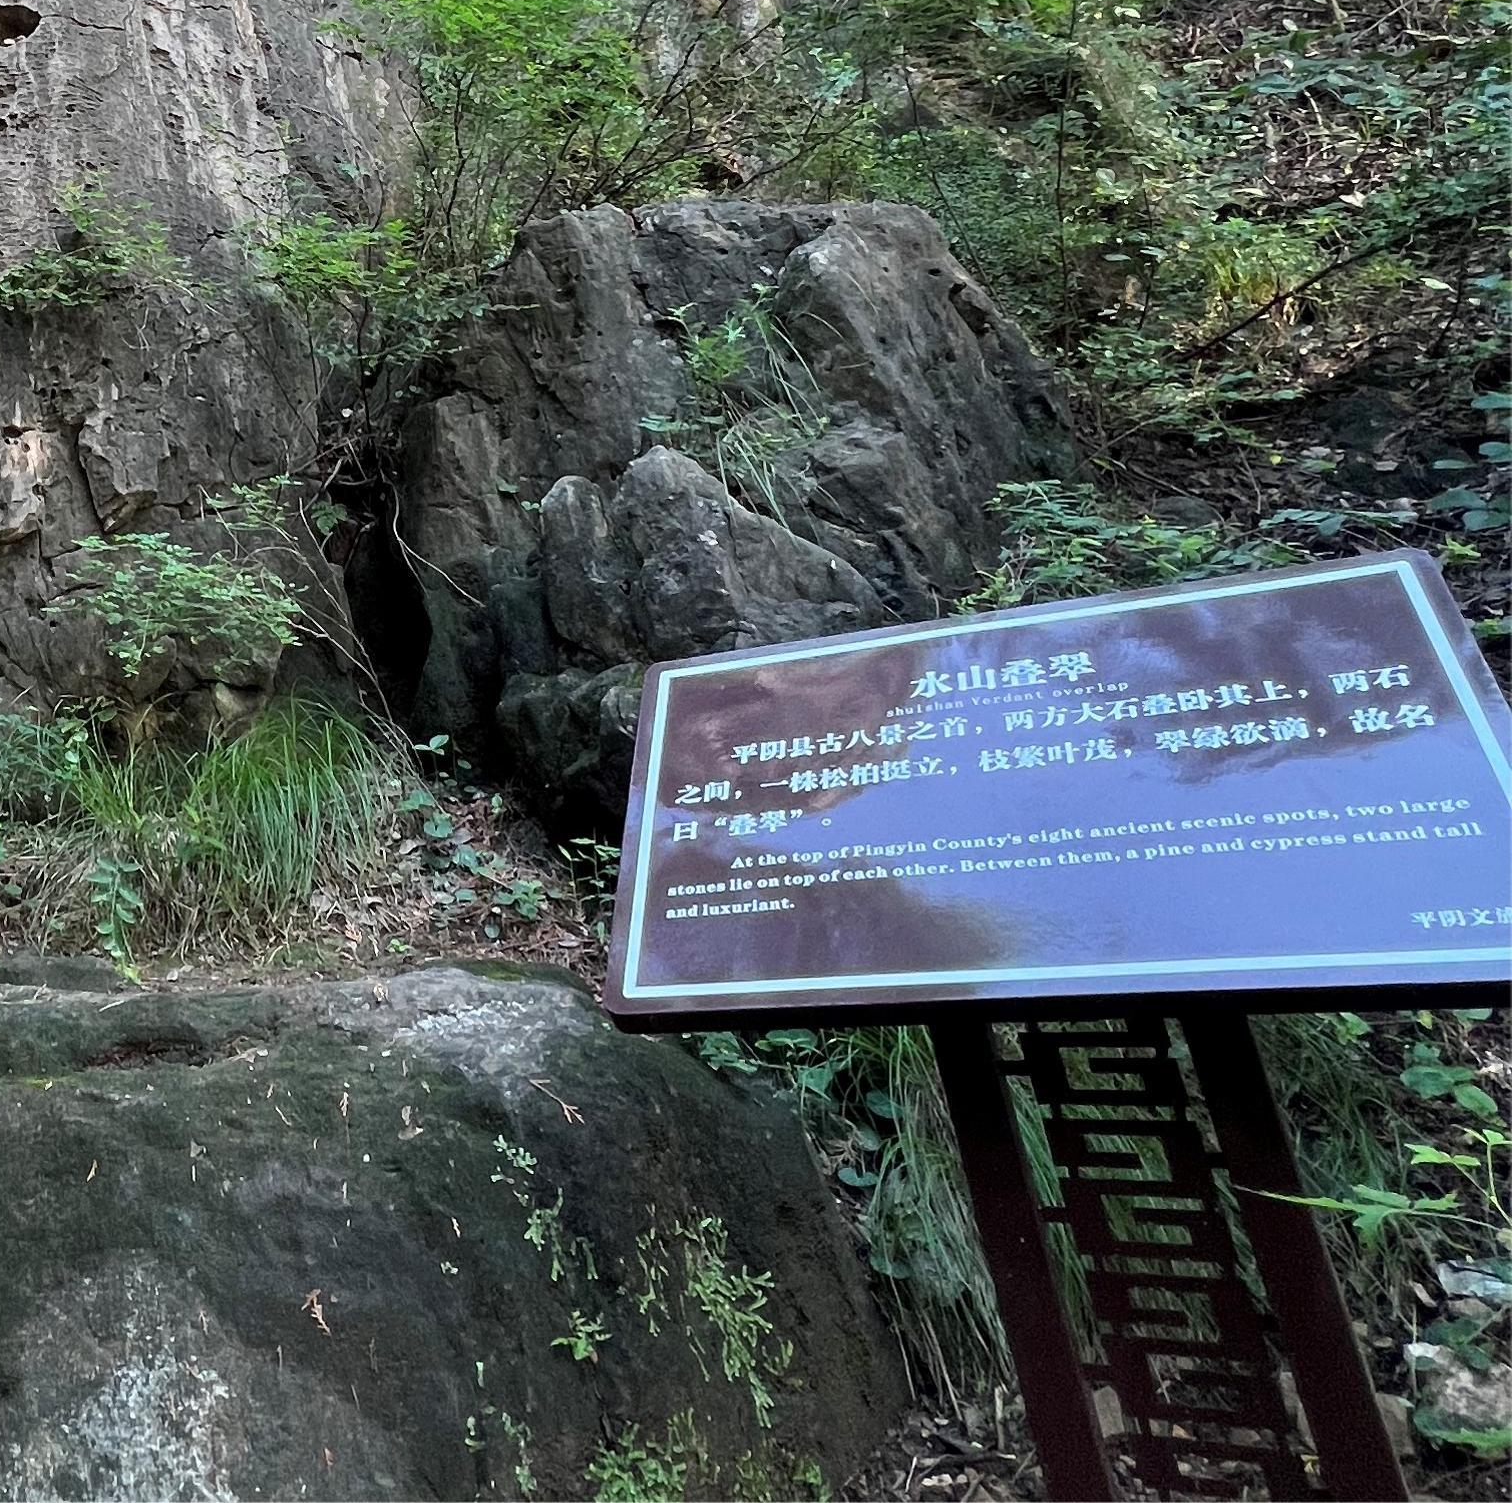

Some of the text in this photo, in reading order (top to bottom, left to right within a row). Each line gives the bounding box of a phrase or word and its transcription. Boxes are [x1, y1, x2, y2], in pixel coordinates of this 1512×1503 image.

[909, 651, 1096, 698] 水山叠翠
[1052, 681, 1129, 698] overlap
[730, 798, 1471, 869] At the top of Pingyin County's eight ancient scenic spots, two large
[667, 821, 1484, 897] stones lie on top of each other. Between them, a pine and cypress stand tall
[665, 897, 796, 919] and luxuriant.
